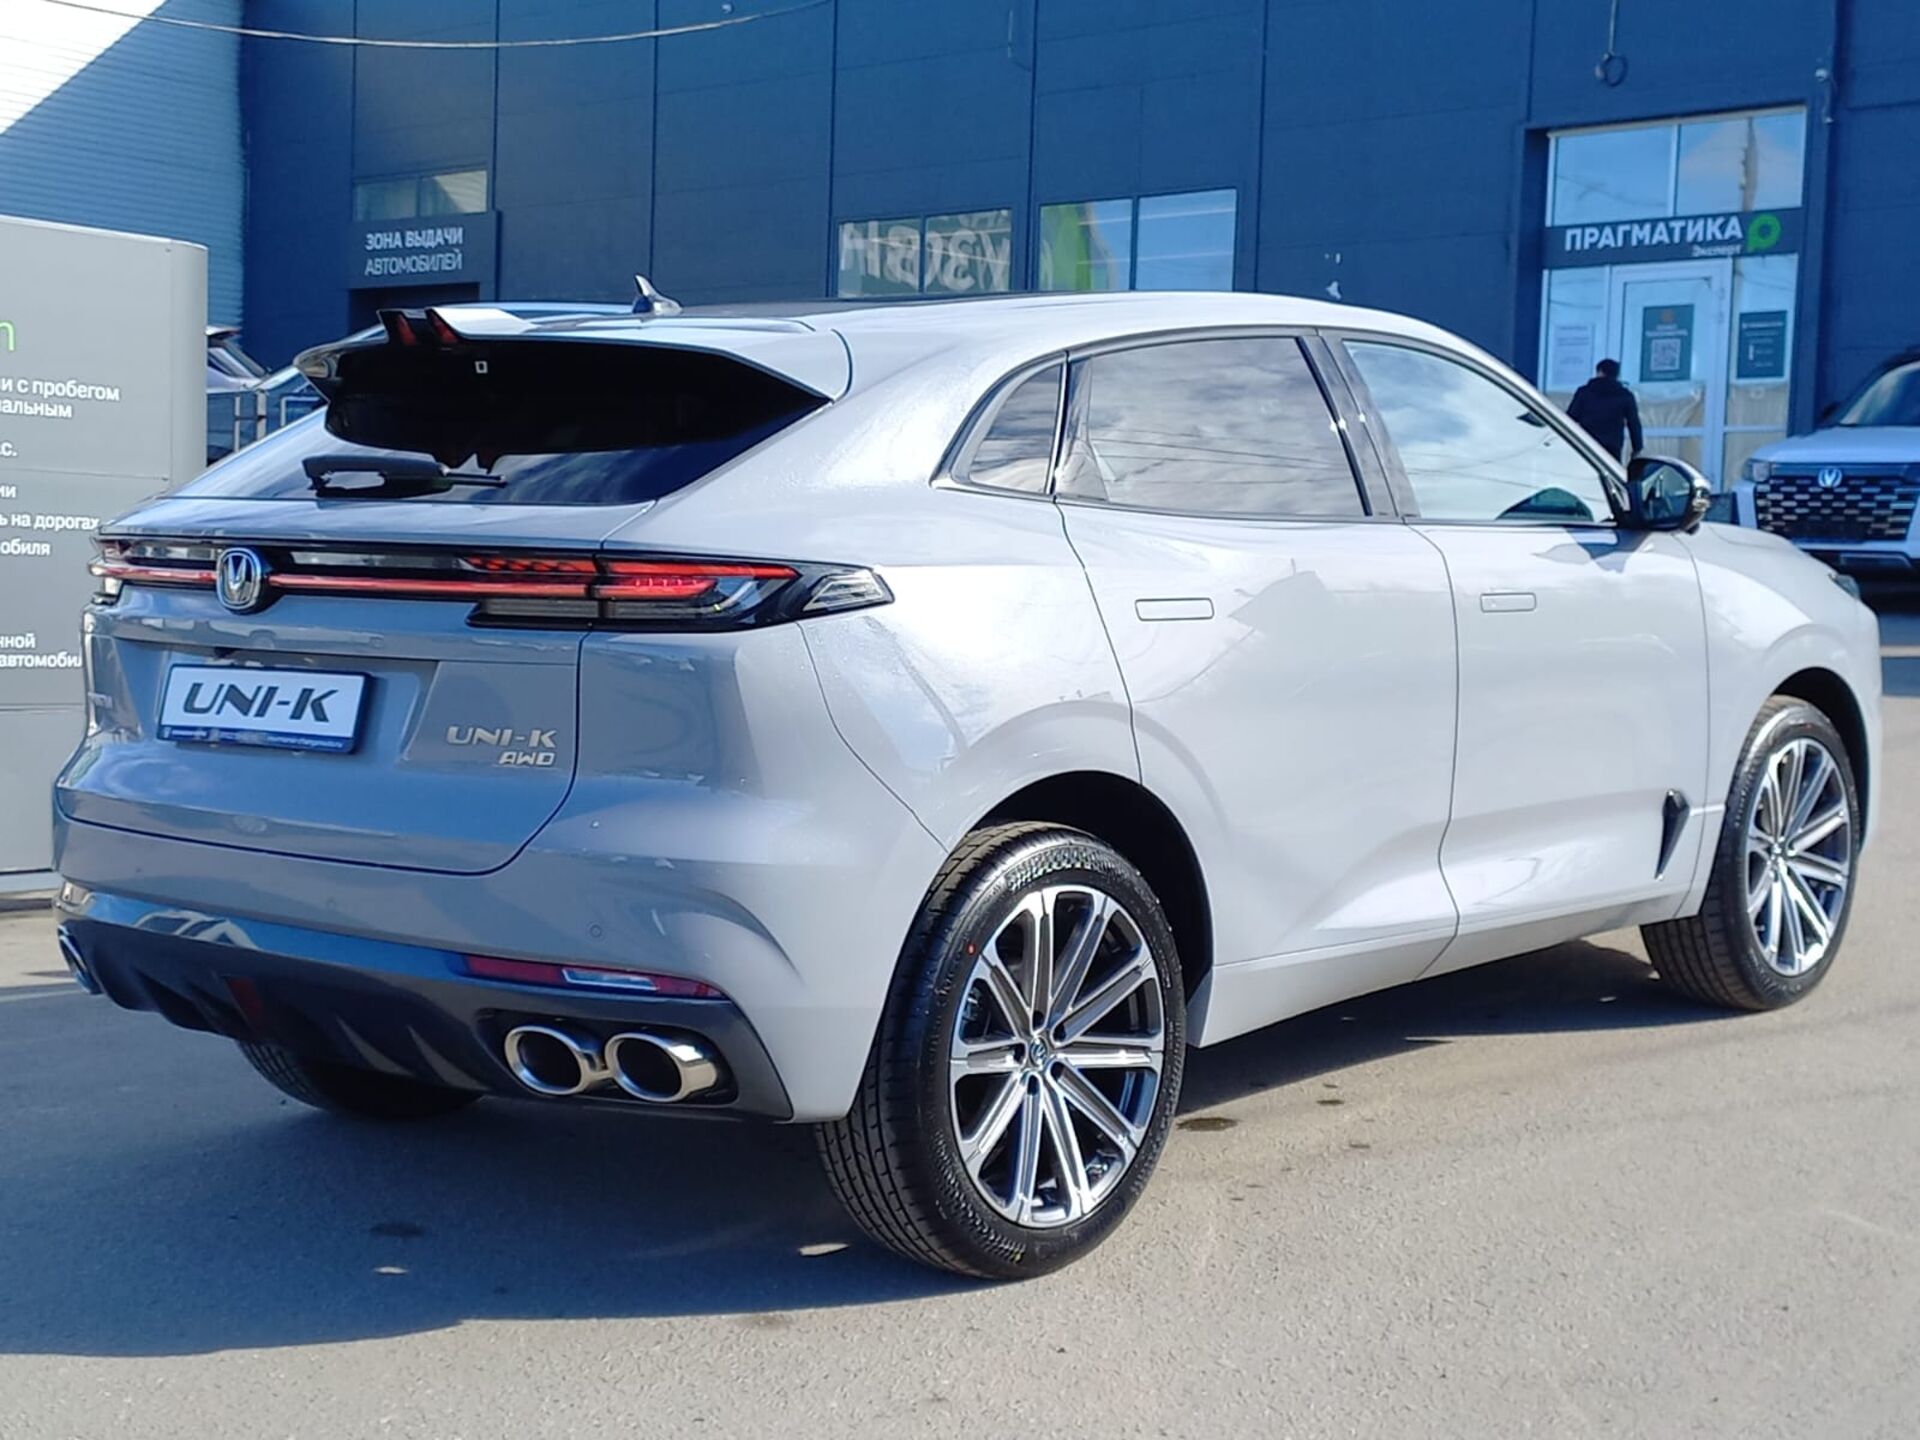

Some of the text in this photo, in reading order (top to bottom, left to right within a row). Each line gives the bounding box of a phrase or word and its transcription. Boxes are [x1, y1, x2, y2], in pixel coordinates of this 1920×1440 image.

[364, 227, 464, 250] ЗОНА ВЫДАЧИ
[1564, 214, 1744, 251] ПРАГМАТИКА
[364, 248, 463, 276] АВТОМОБИЛЕЙ
[32, 379, 120, 401] пробегом
[0, 398, 73, 418] альным
[11, 513, 31, 527] на
[33, 514, 99, 532] дорогах
[182, 681, 340, 723] UNI-K
[445, 725, 558, 749] UNI-K
[498, 750, 557, 767] AWD
